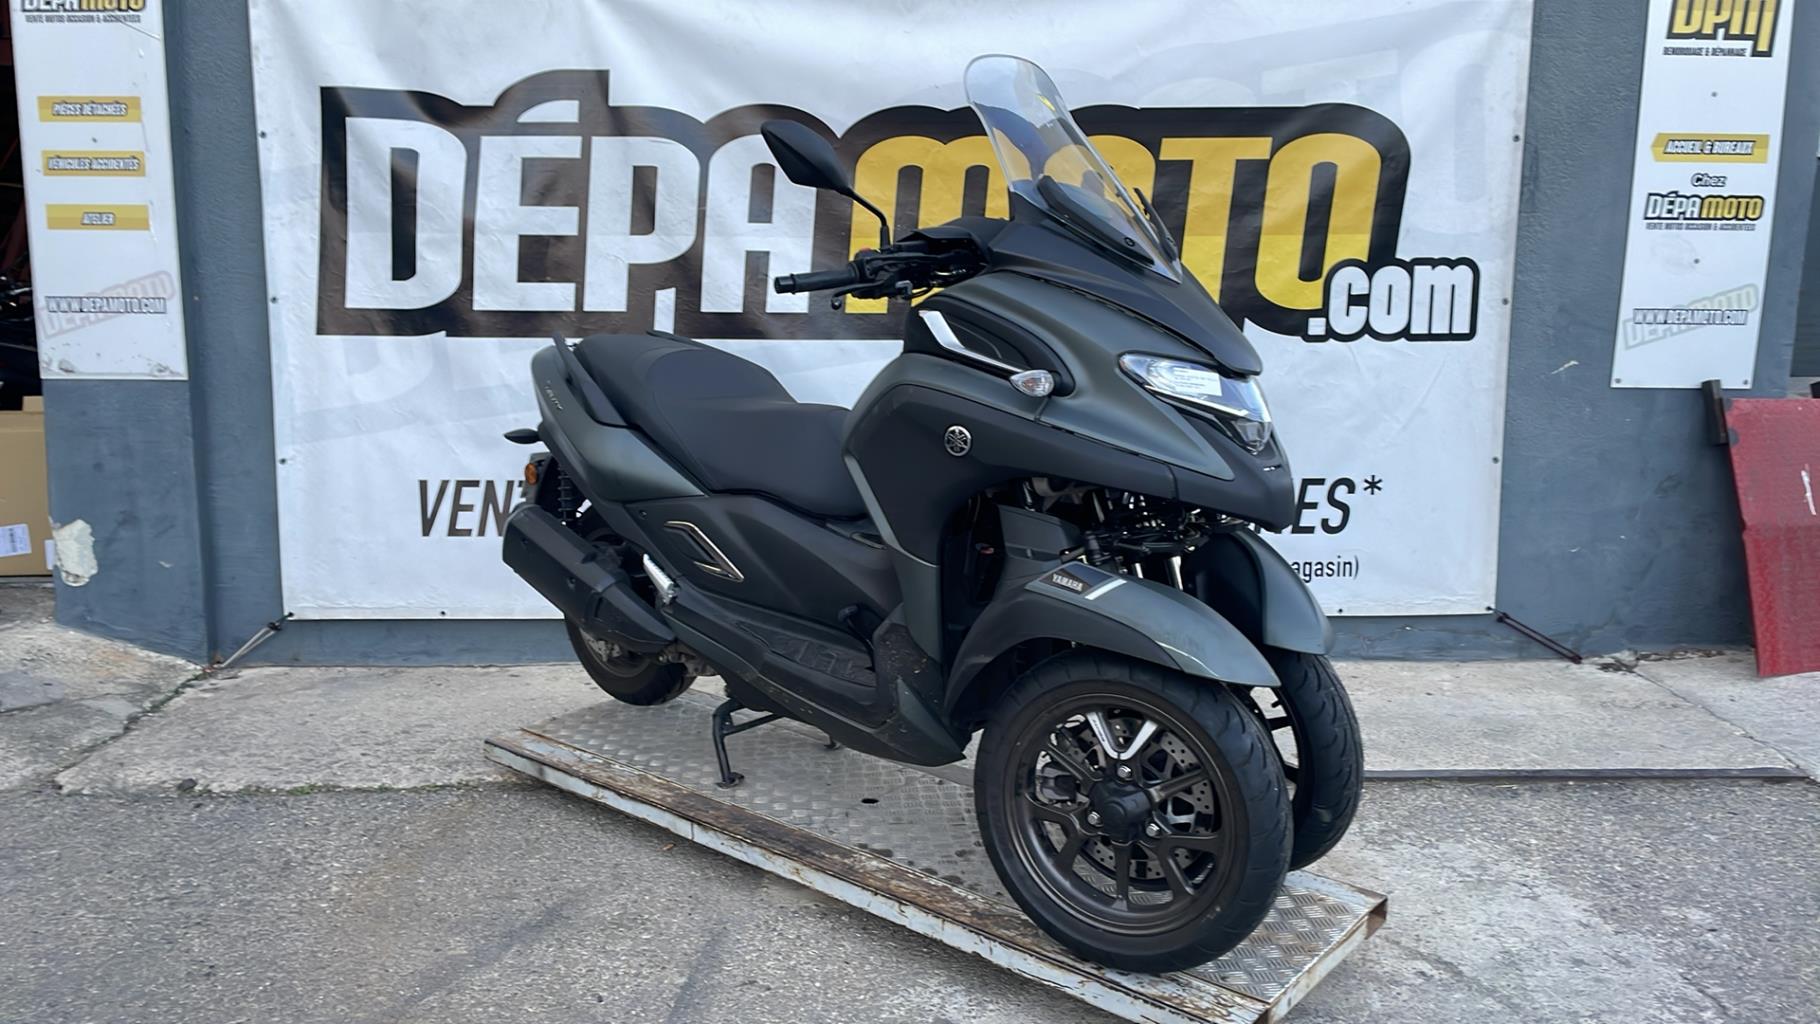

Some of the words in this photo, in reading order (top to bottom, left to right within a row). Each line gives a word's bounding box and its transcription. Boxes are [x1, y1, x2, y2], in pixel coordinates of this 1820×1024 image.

[1691, 173, 1727, 187] Chez
[1646, 191, 1764, 220] DÉPAMOTO
[45, 296, 167, 314] WWW.DEPAMOTO.COM
[1633, 308, 1748, 325] WWW.DEPAMOTO.COM
[418, 479, 527, 537] VEN
[1291, 556, 1359, 583] agasin)
[1052, 573, 1083, 592] YAMAHA
